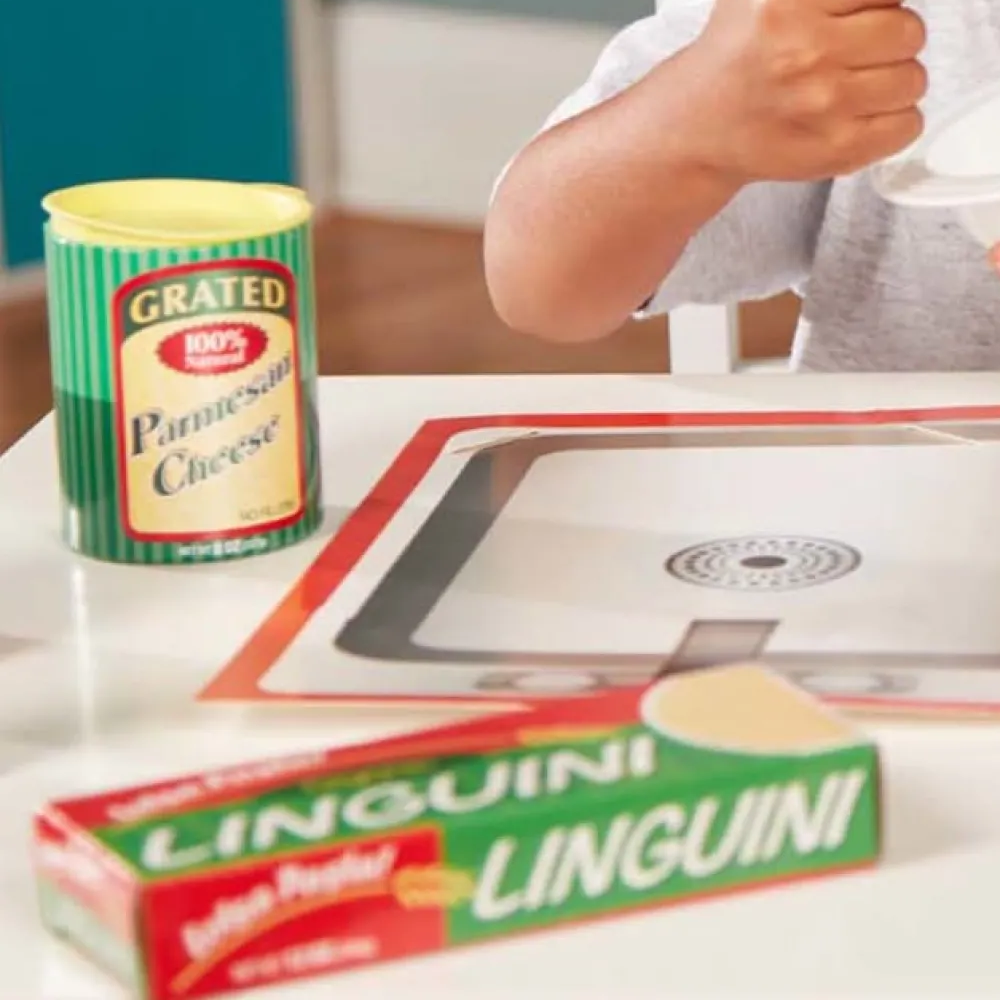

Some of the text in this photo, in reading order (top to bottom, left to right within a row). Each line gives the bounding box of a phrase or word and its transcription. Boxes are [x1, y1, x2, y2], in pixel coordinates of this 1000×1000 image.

[130, 275, 286, 324] GRATED
[184, 328, 248, 354] 100%
[131, 352, 291, 456] Parmesan
[153, 415, 280, 496] Cheese
[141, 734, 656, 870] LINGUINI
[472, 768, 867, 921] LINGUINI
